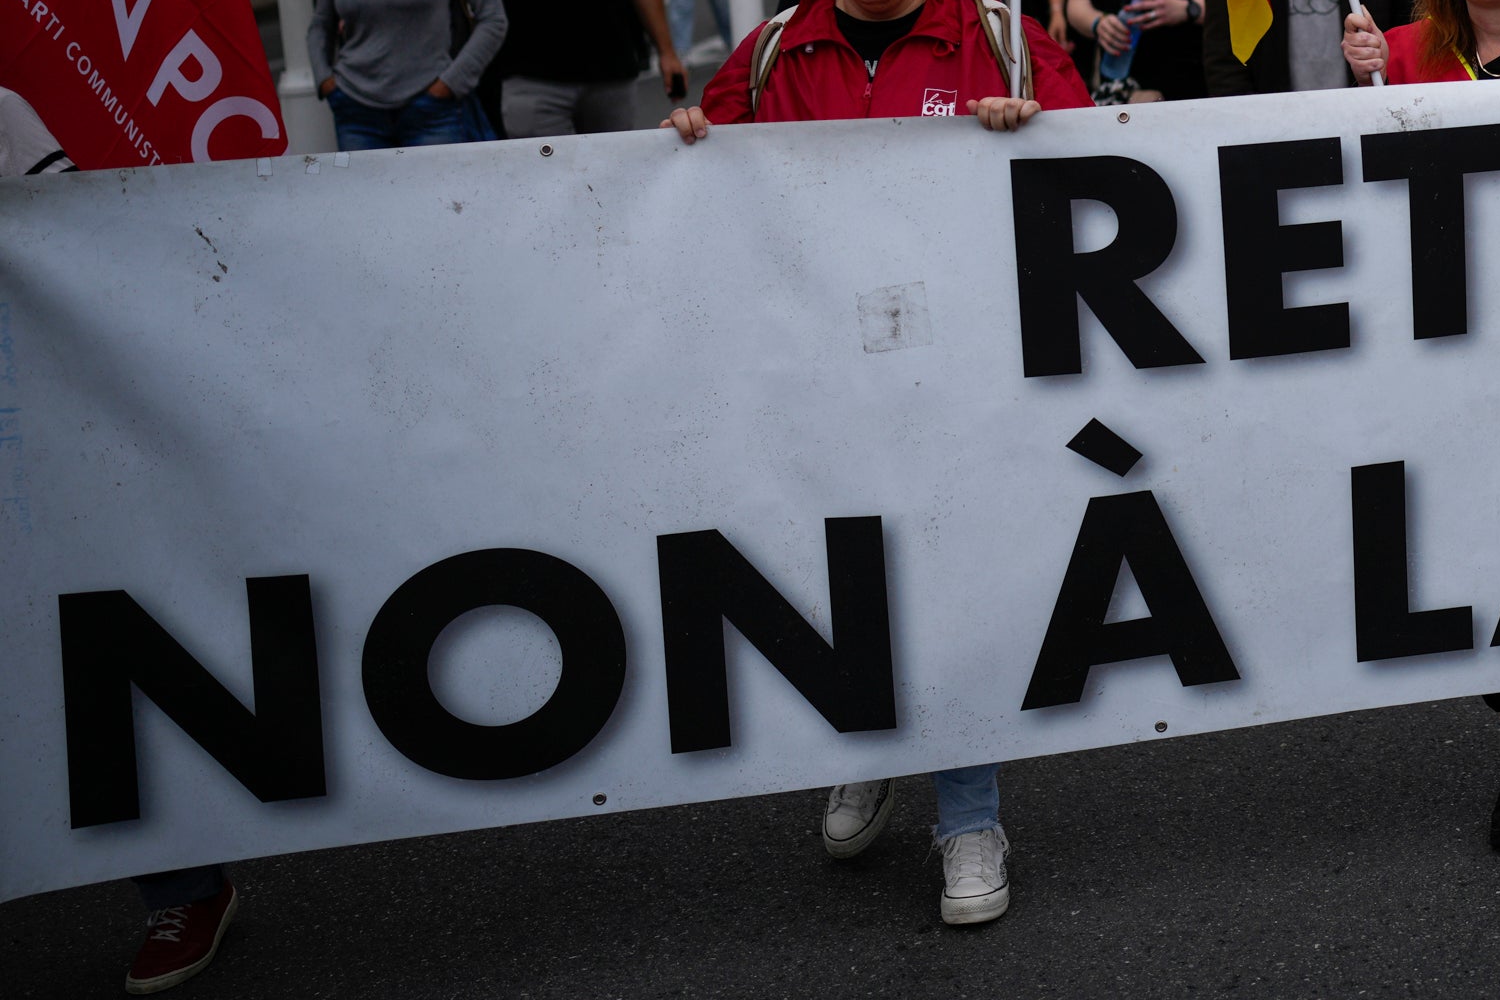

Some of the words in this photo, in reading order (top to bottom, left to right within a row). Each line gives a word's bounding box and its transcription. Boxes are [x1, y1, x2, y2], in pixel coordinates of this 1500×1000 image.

[66, 41, 165, 165] COMMUNIST
[58, 515, 898, 830] NON
[1021, 417, 1242, 711] À
